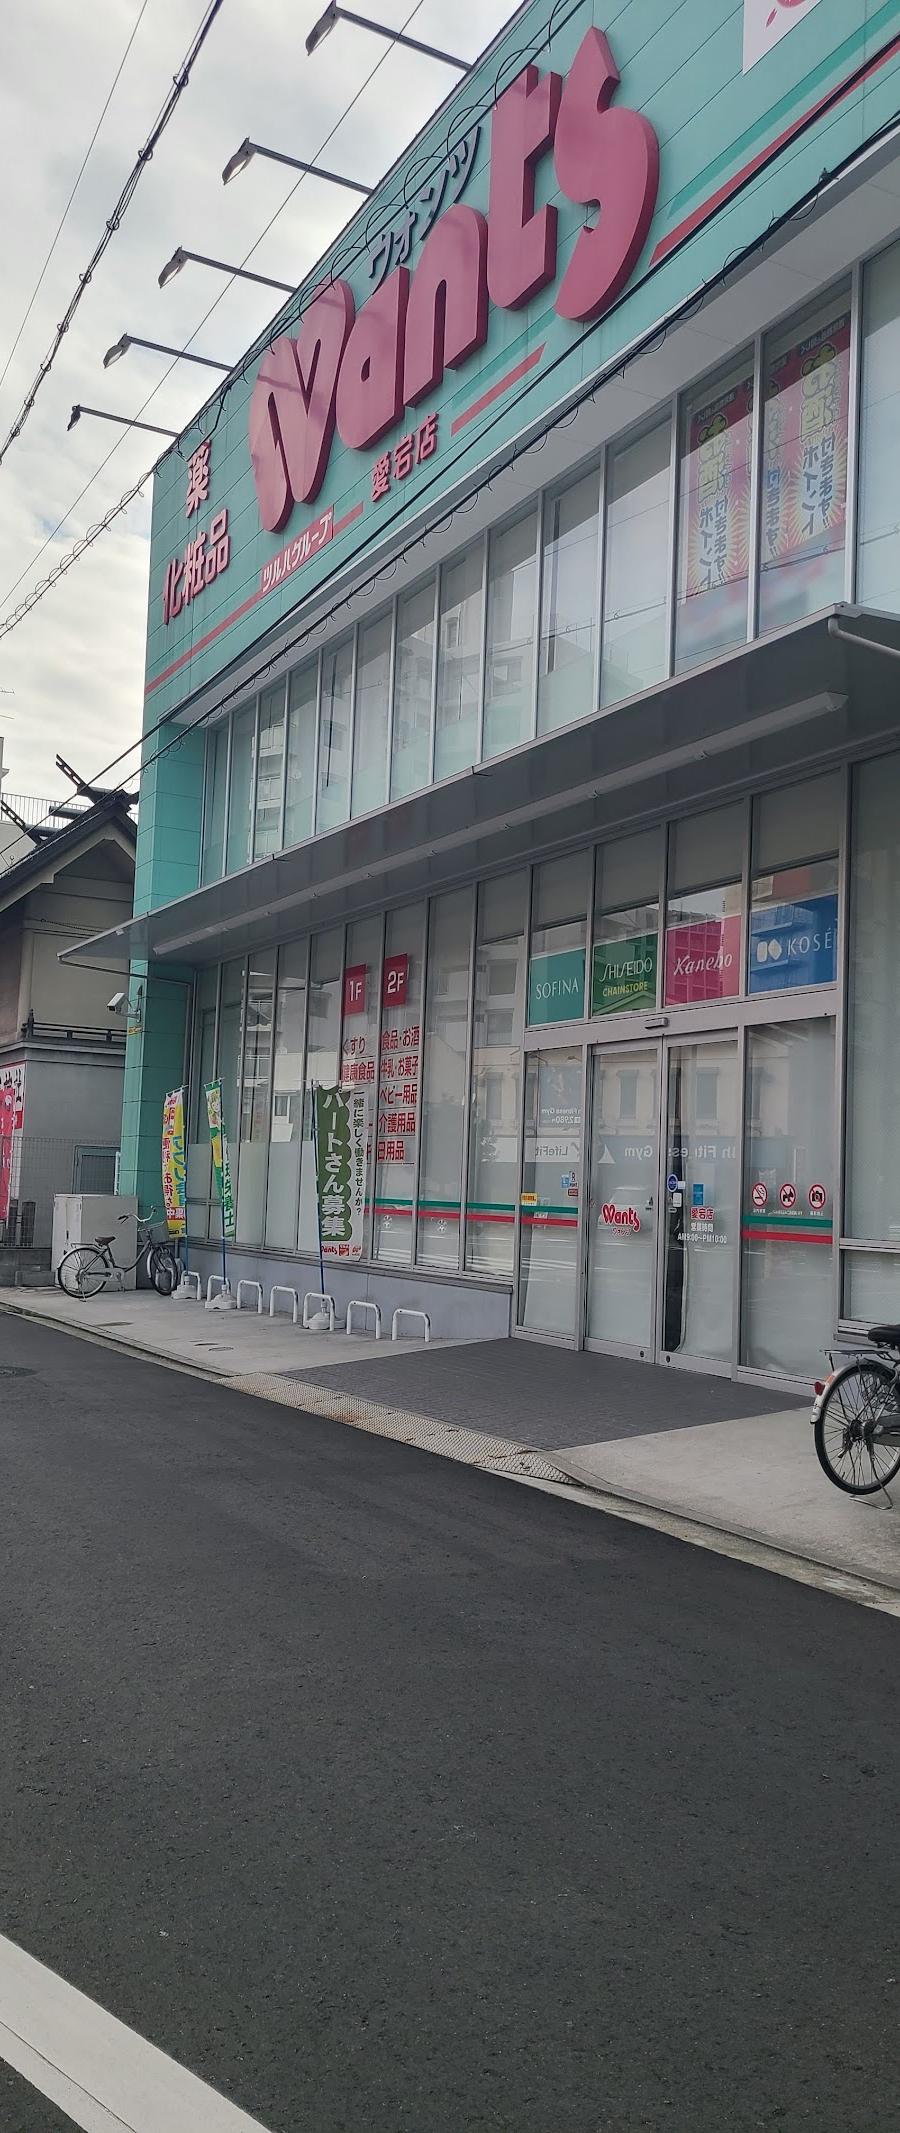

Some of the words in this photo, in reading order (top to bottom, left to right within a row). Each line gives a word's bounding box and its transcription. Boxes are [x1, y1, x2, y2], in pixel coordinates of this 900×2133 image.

[371, 412, 438, 502] 愛宕店
[186, 439, 211, 518] 薬
[263, 511, 332, 593] ツルハグループ
[163, 508, 230, 625] 化粧品
[787, 928, 833, 957] KOSÉ
[599, 957, 653, 982] SHISEIDO
[673, 953, 734, 977] Kanebo
[349, 981, 362, 1002] 1F
[387, 970, 404, 994] 2F
[536, 977, 579, 1000] SOFINA
[602, 981, 648, 997] CHAINSTORE
[342, 1036, 366, 1056] くすり
[341, 1061, 375, 1084] 健康食品
[379, 1084, 418, 1106] ベビー用品
[378, 1111, 416, 1134] 介護用品
[322, 1088, 346, 1237] パートさん募集
[377, 1140, 405, 1161] 日用品
